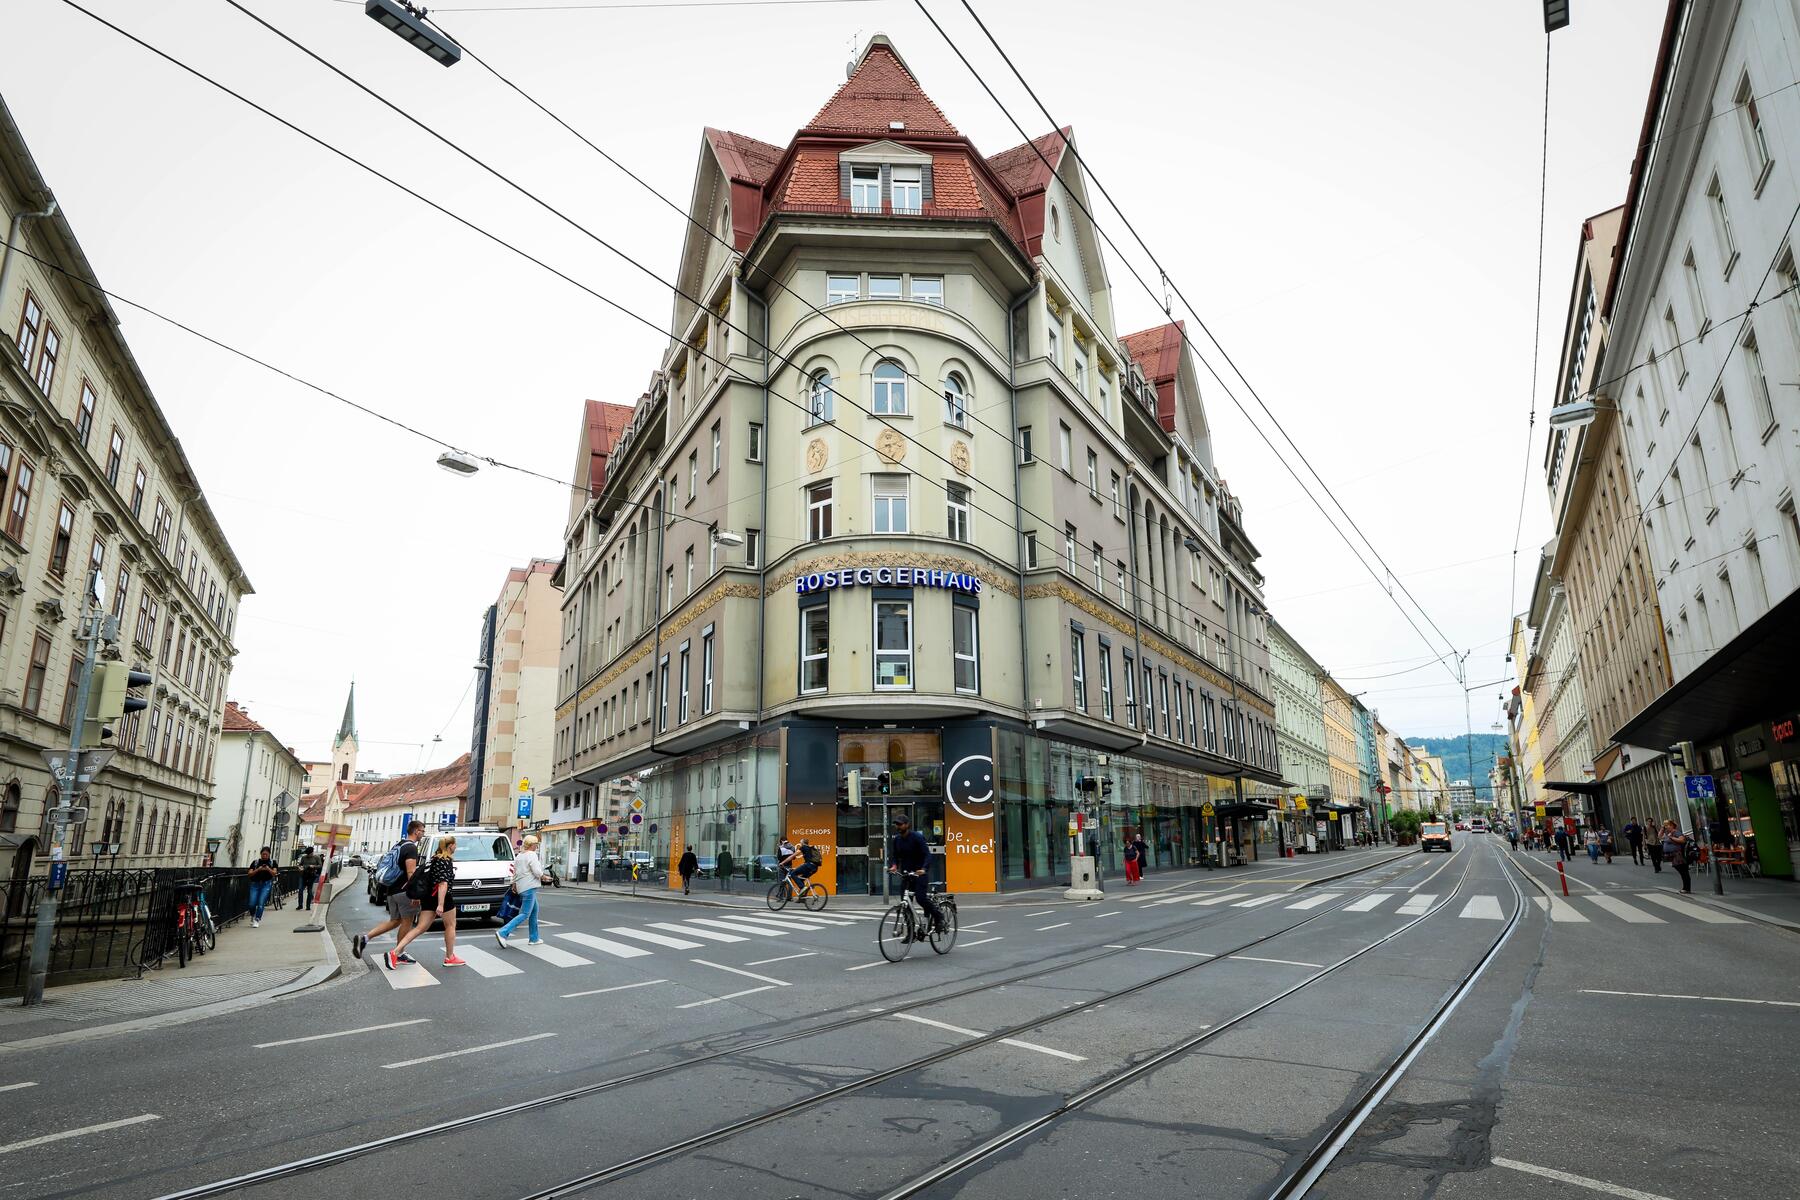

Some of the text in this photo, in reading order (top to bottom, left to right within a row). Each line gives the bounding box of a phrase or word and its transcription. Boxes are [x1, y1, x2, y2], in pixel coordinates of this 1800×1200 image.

[795, 567, 983, 593] ROSEGGERHAUS
[947, 827, 963, 842] be
[957, 838, 994, 854] nice!
